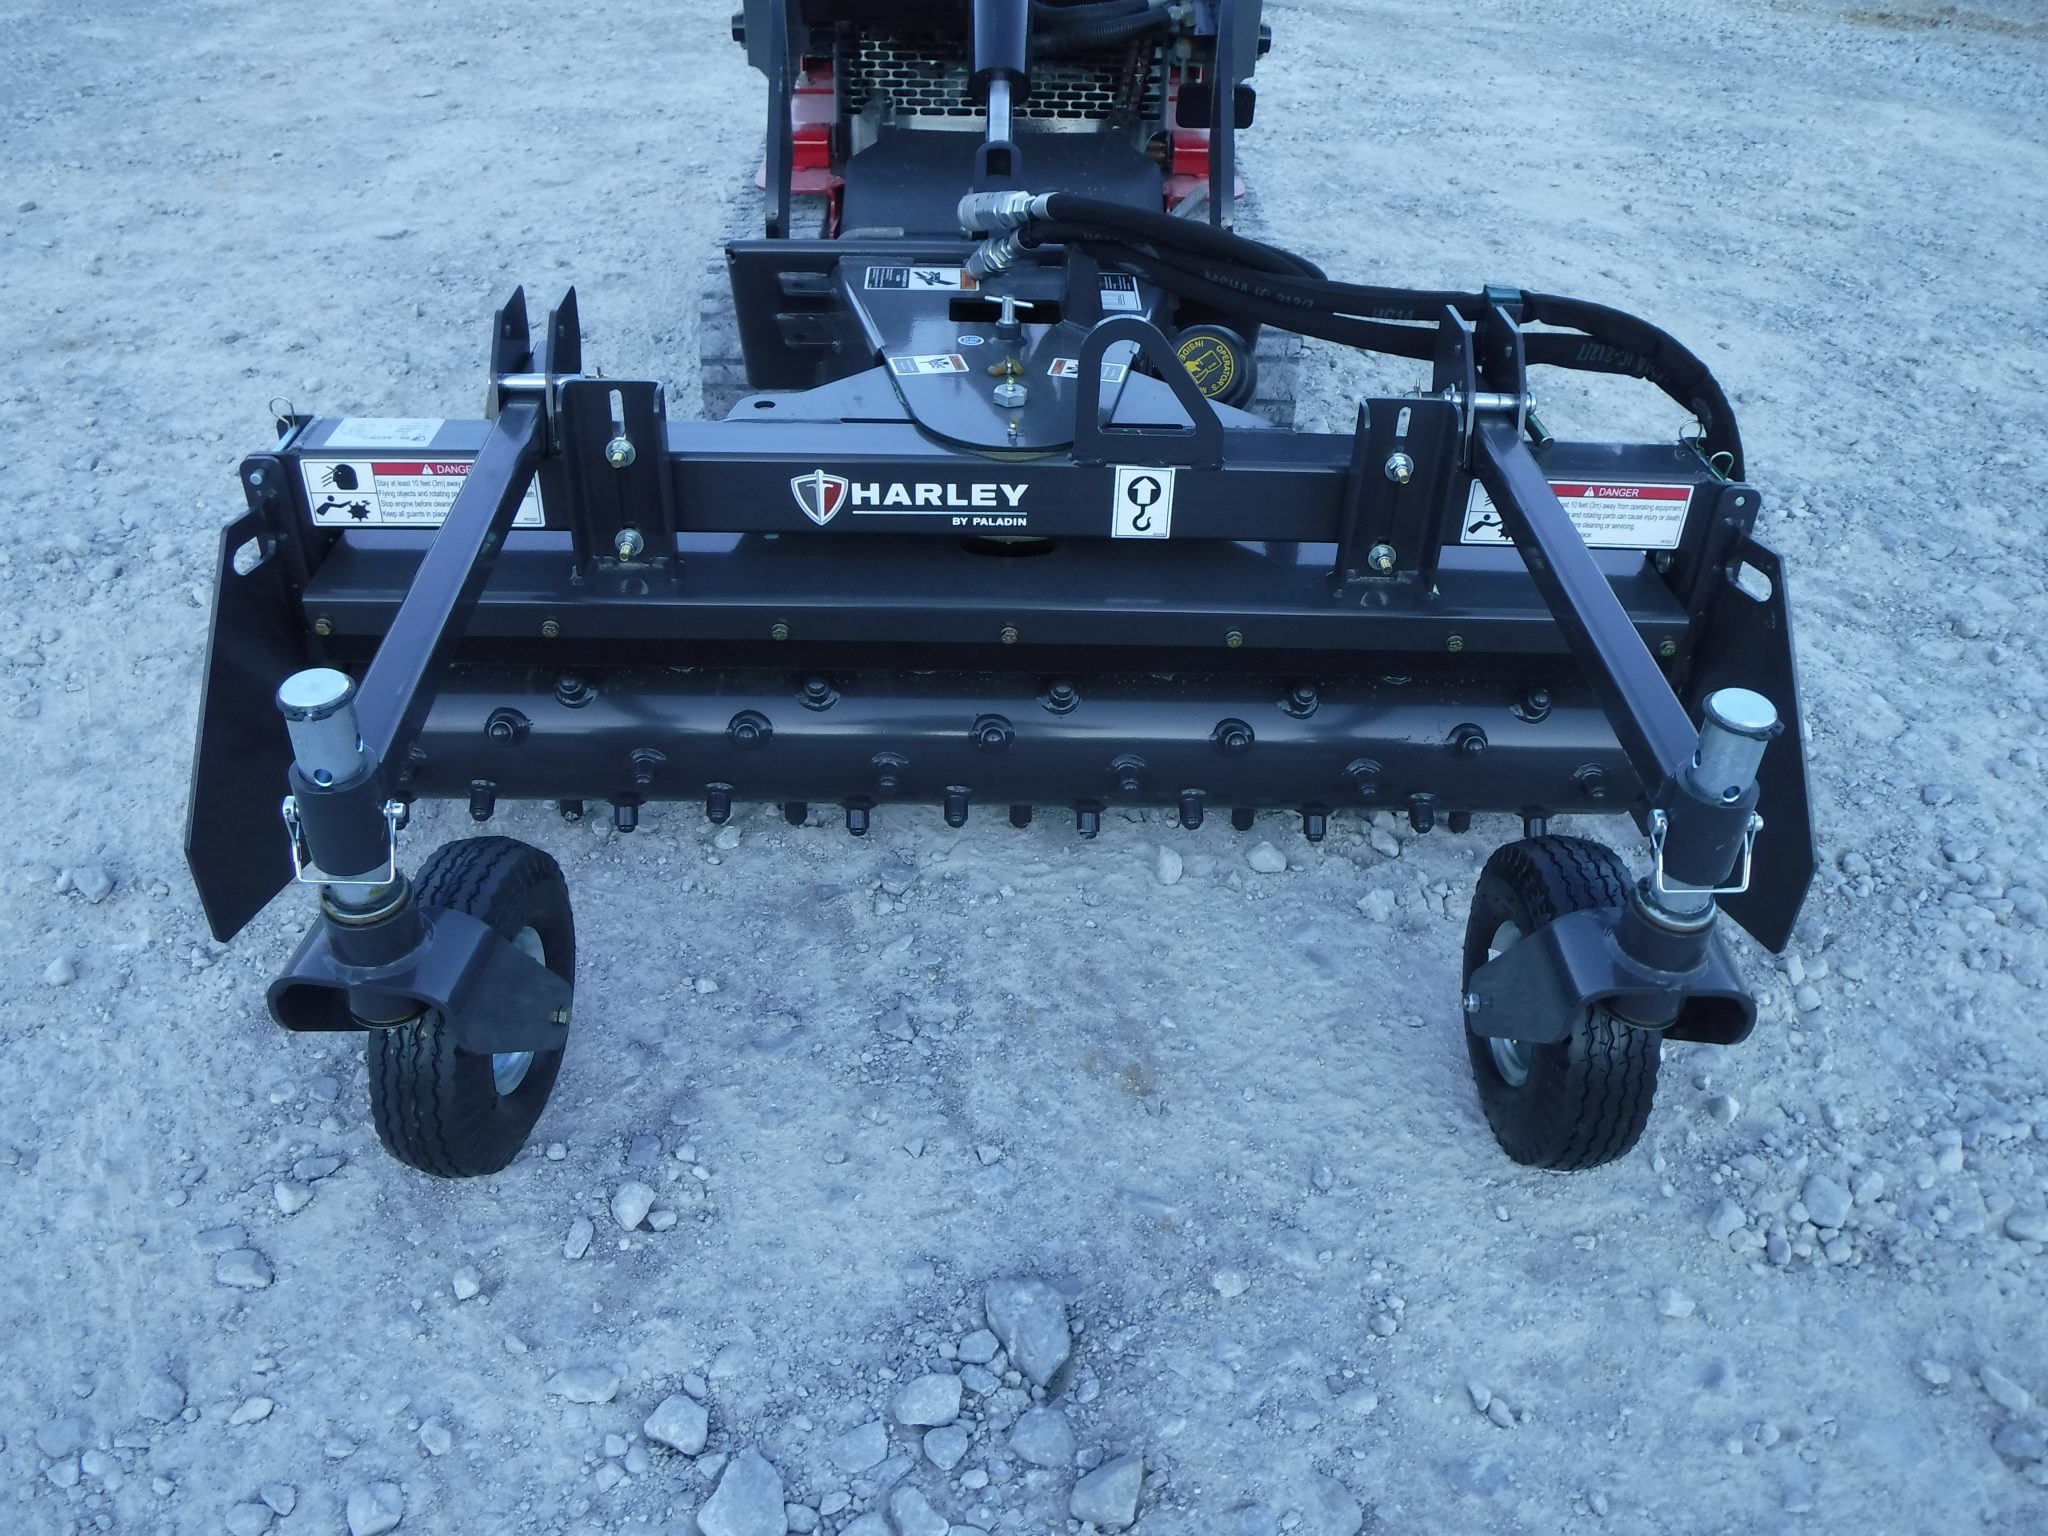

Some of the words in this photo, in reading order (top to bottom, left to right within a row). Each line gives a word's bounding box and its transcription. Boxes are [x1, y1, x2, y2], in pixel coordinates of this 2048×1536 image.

[1180, 340, 1204, 361] INSIDE
[1211, 345, 1231, 391] OPERATOR'S
[436, 465, 472, 474] DANGE
[376, 480, 389, 488] Stay
[432, 480, 446, 488] (3m)
[379, 490, 396, 498] Flying
[397, 490, 416, 498] objects
[429, 490, 450, 498] rotating
[851, 482, 1029, 507] HARLEY
[1598, 487, 1640, 498] DANGER
[381, 500, 394, 508] Stop
[1602, 503, 1617, 511] away
[1630, 504, 1655, 512] operating
[383, 510, 397, 518] Keep
[1582, 512, 1602, 520] rotating
[952, 517, 968, 526] BY
[972, 517, 1027, 527] PALADIN
[1582, 522, 1604, 530] cleaning
